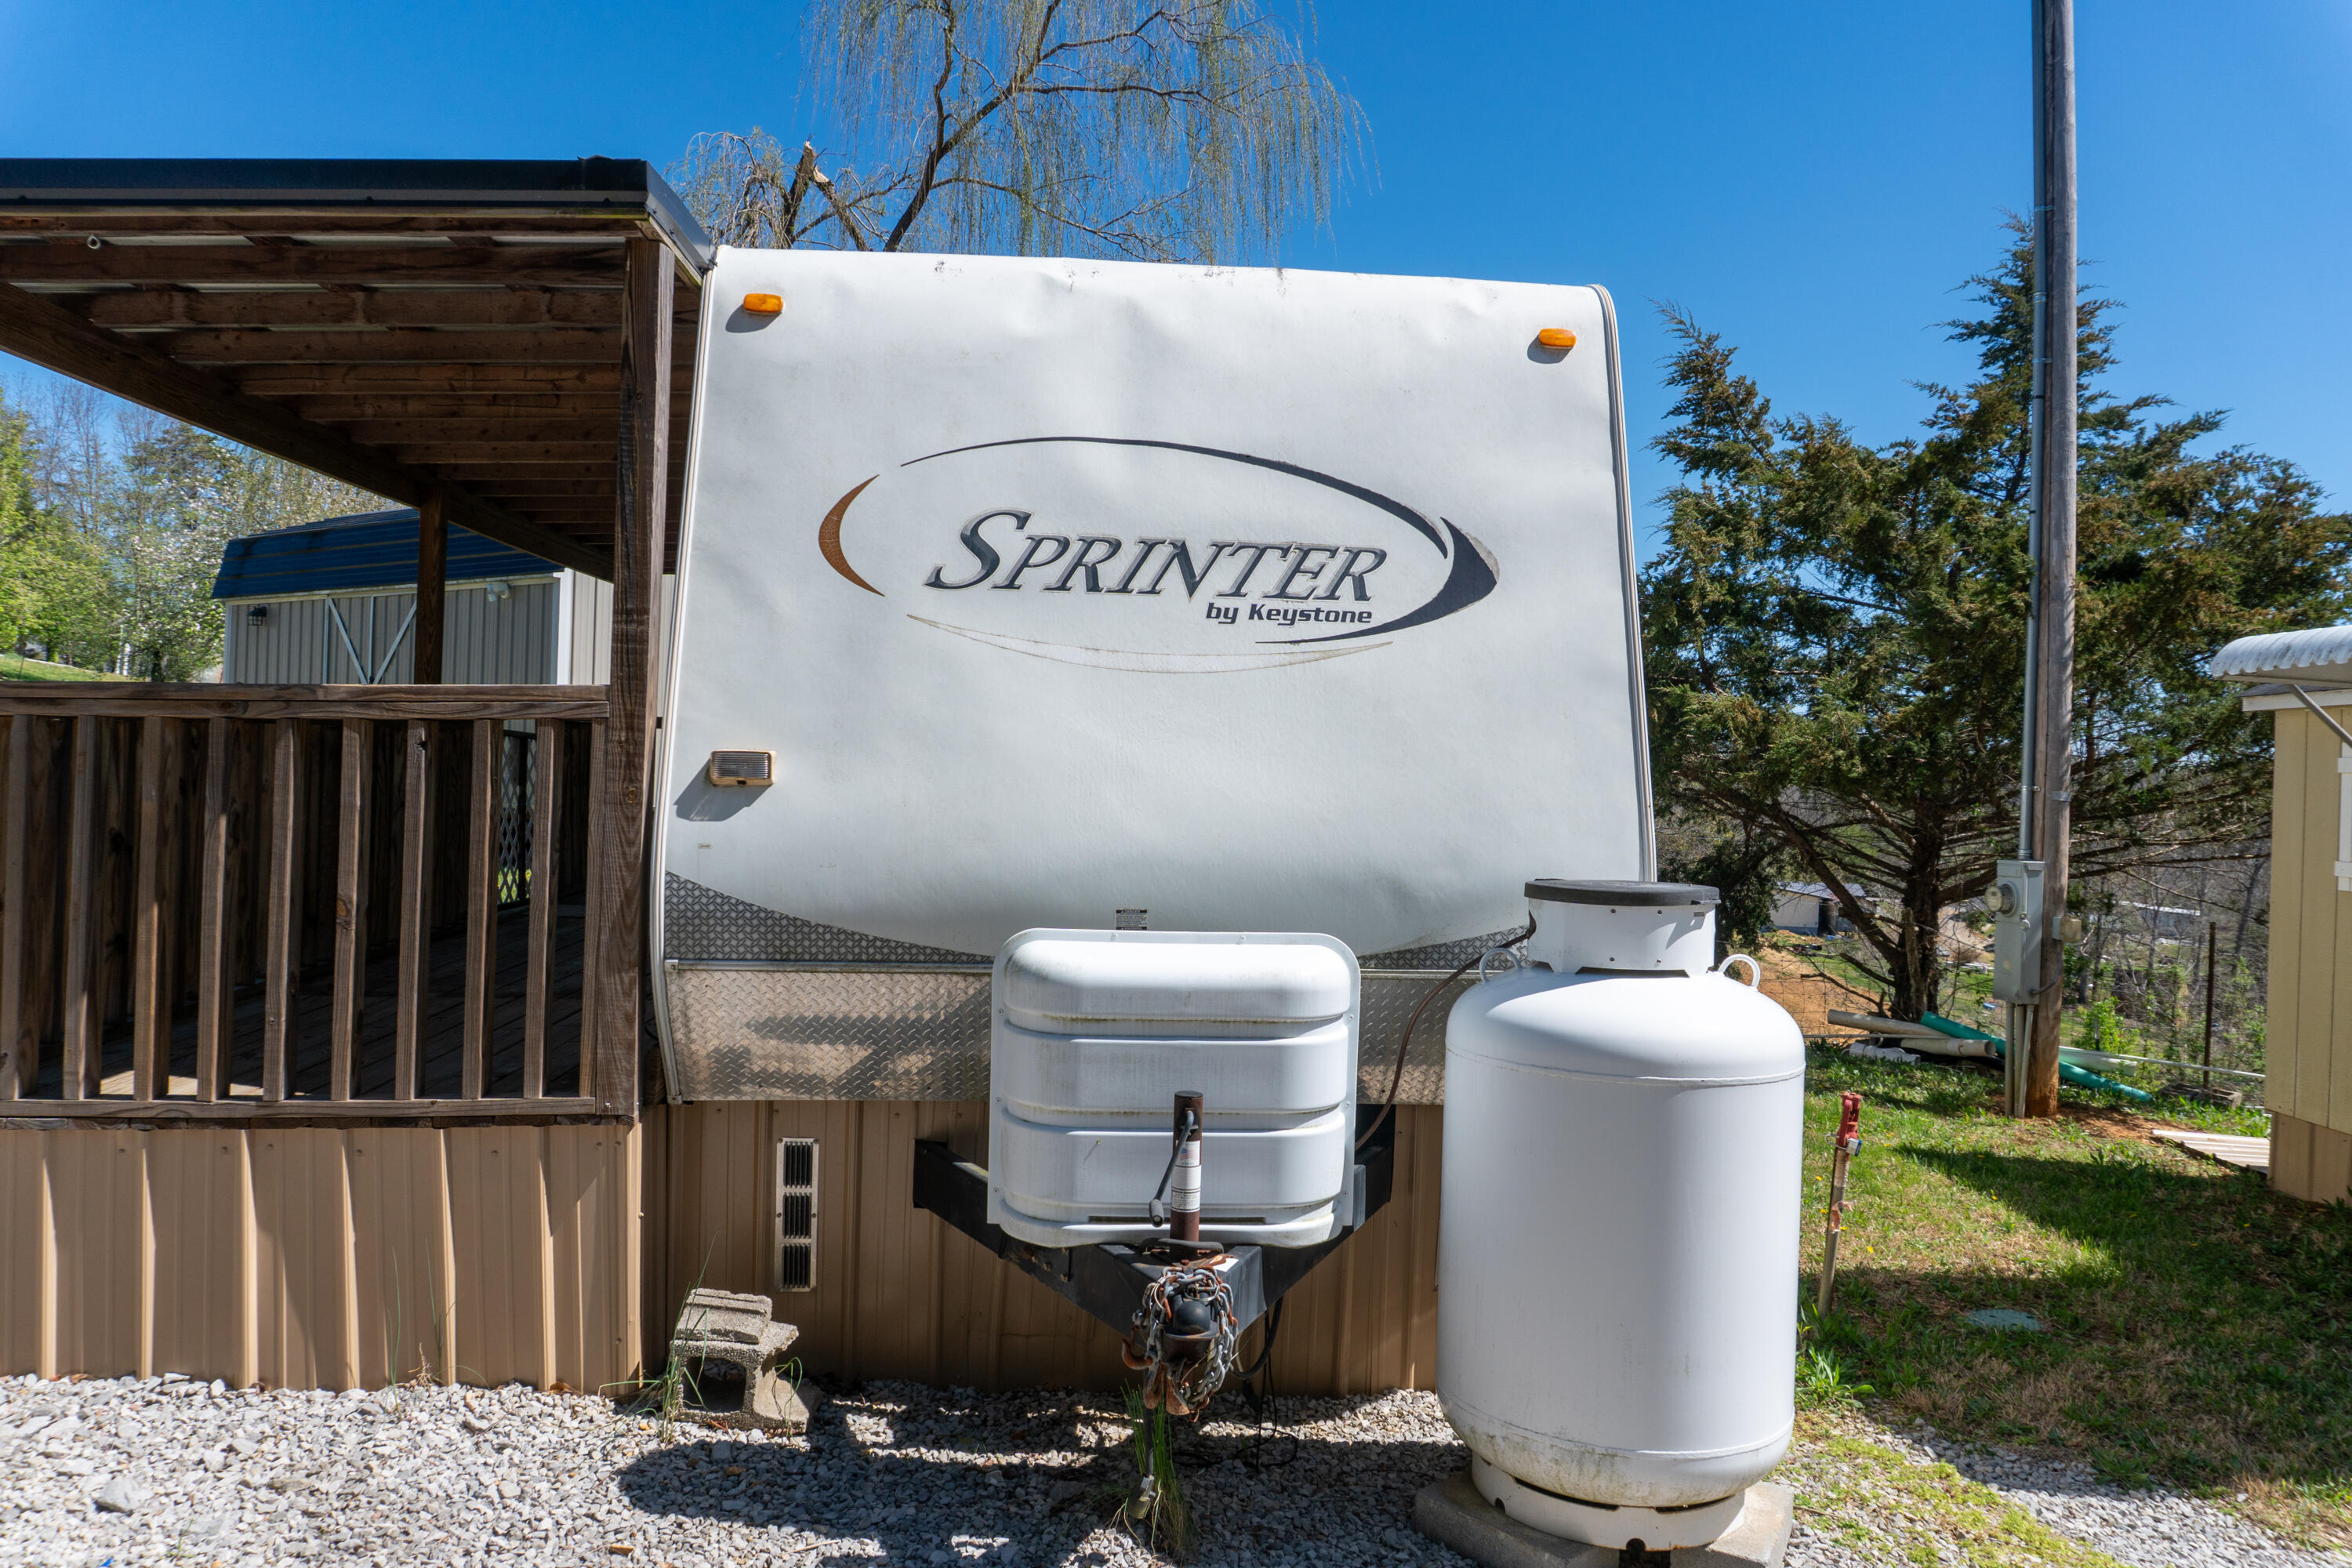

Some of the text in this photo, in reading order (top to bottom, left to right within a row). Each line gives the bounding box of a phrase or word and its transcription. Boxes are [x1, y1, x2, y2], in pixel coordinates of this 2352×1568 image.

[922, 508, 1388, 601] SPRINTER
[1206, 602, 1372, 626] by Keystone
